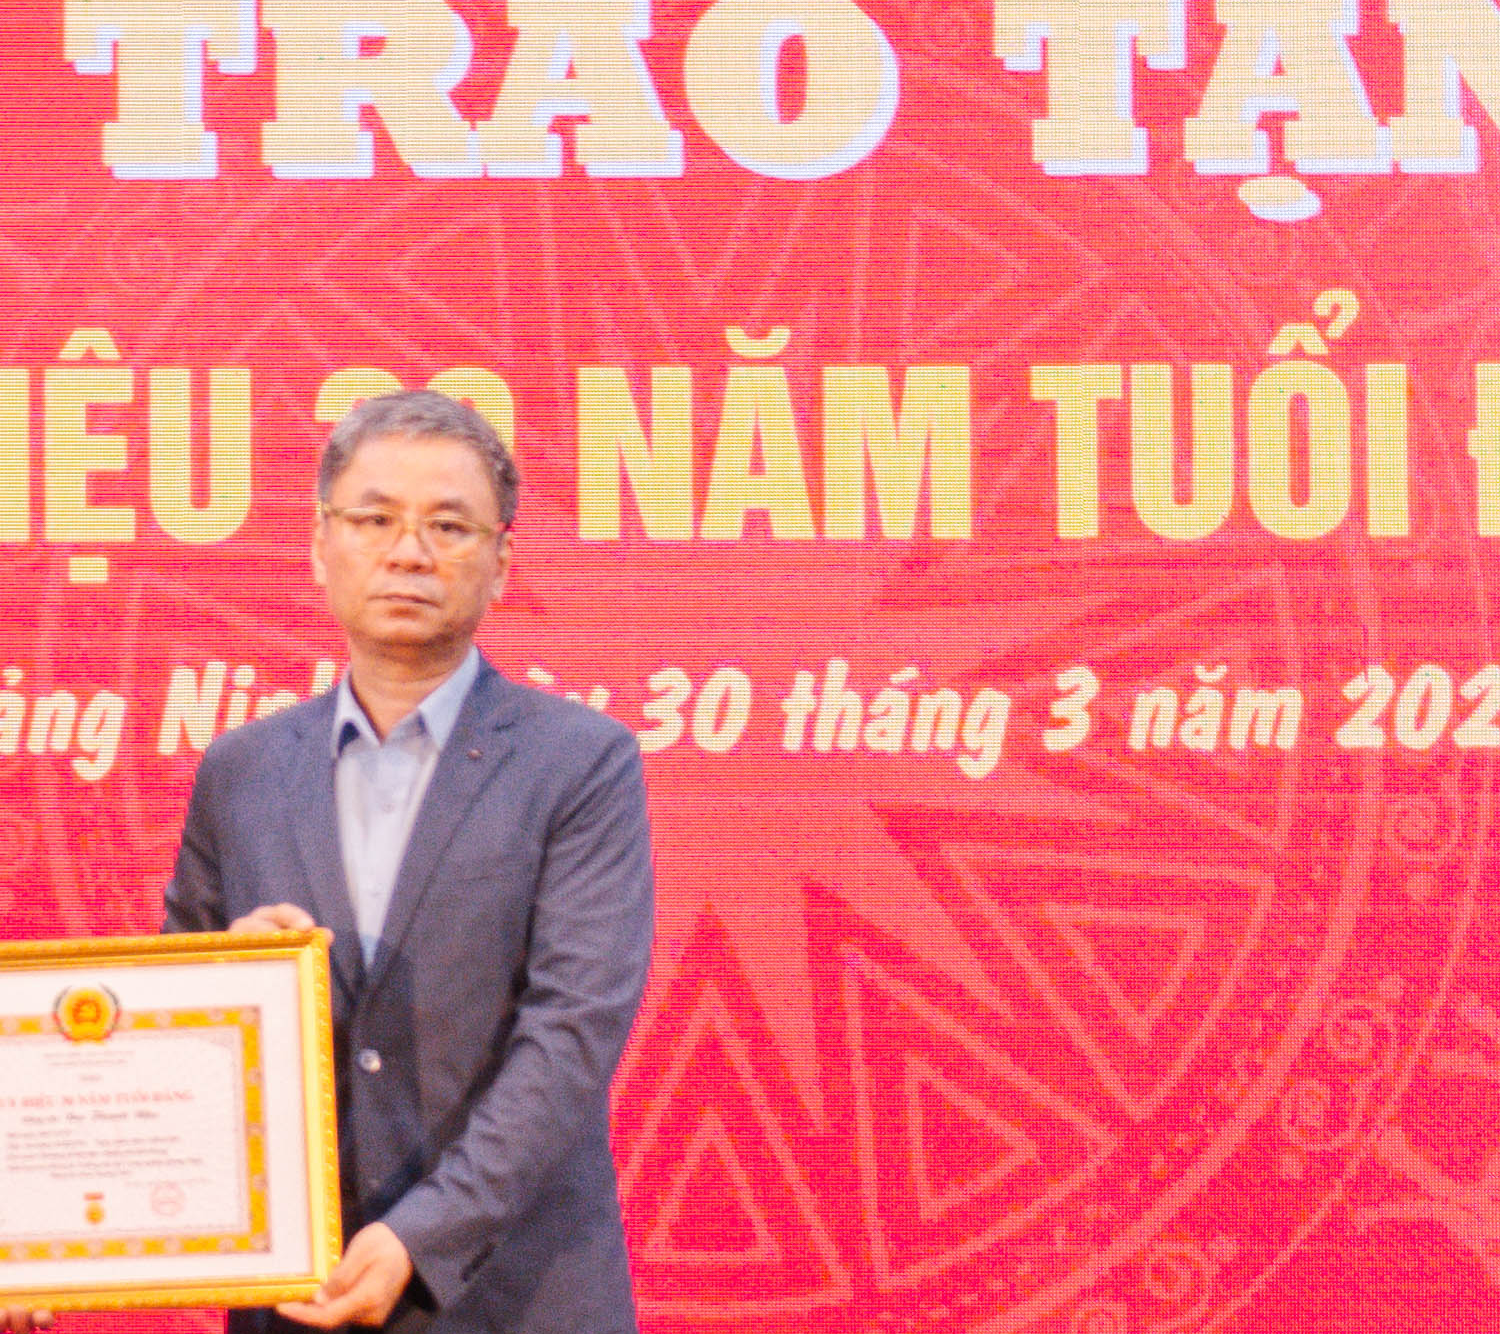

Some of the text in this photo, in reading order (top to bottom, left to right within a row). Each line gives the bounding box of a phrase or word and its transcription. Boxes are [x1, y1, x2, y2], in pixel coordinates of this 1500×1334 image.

[579, 328, 971, 539] NĂM
[1032, 290, 1409, 540] TUỔI
[637, 668, 750, 752] 30
[782, 660, 1010, 778] tháng
[1044, 667, 1098, 750] 3
[1130, 666, 1302, 750] năm
